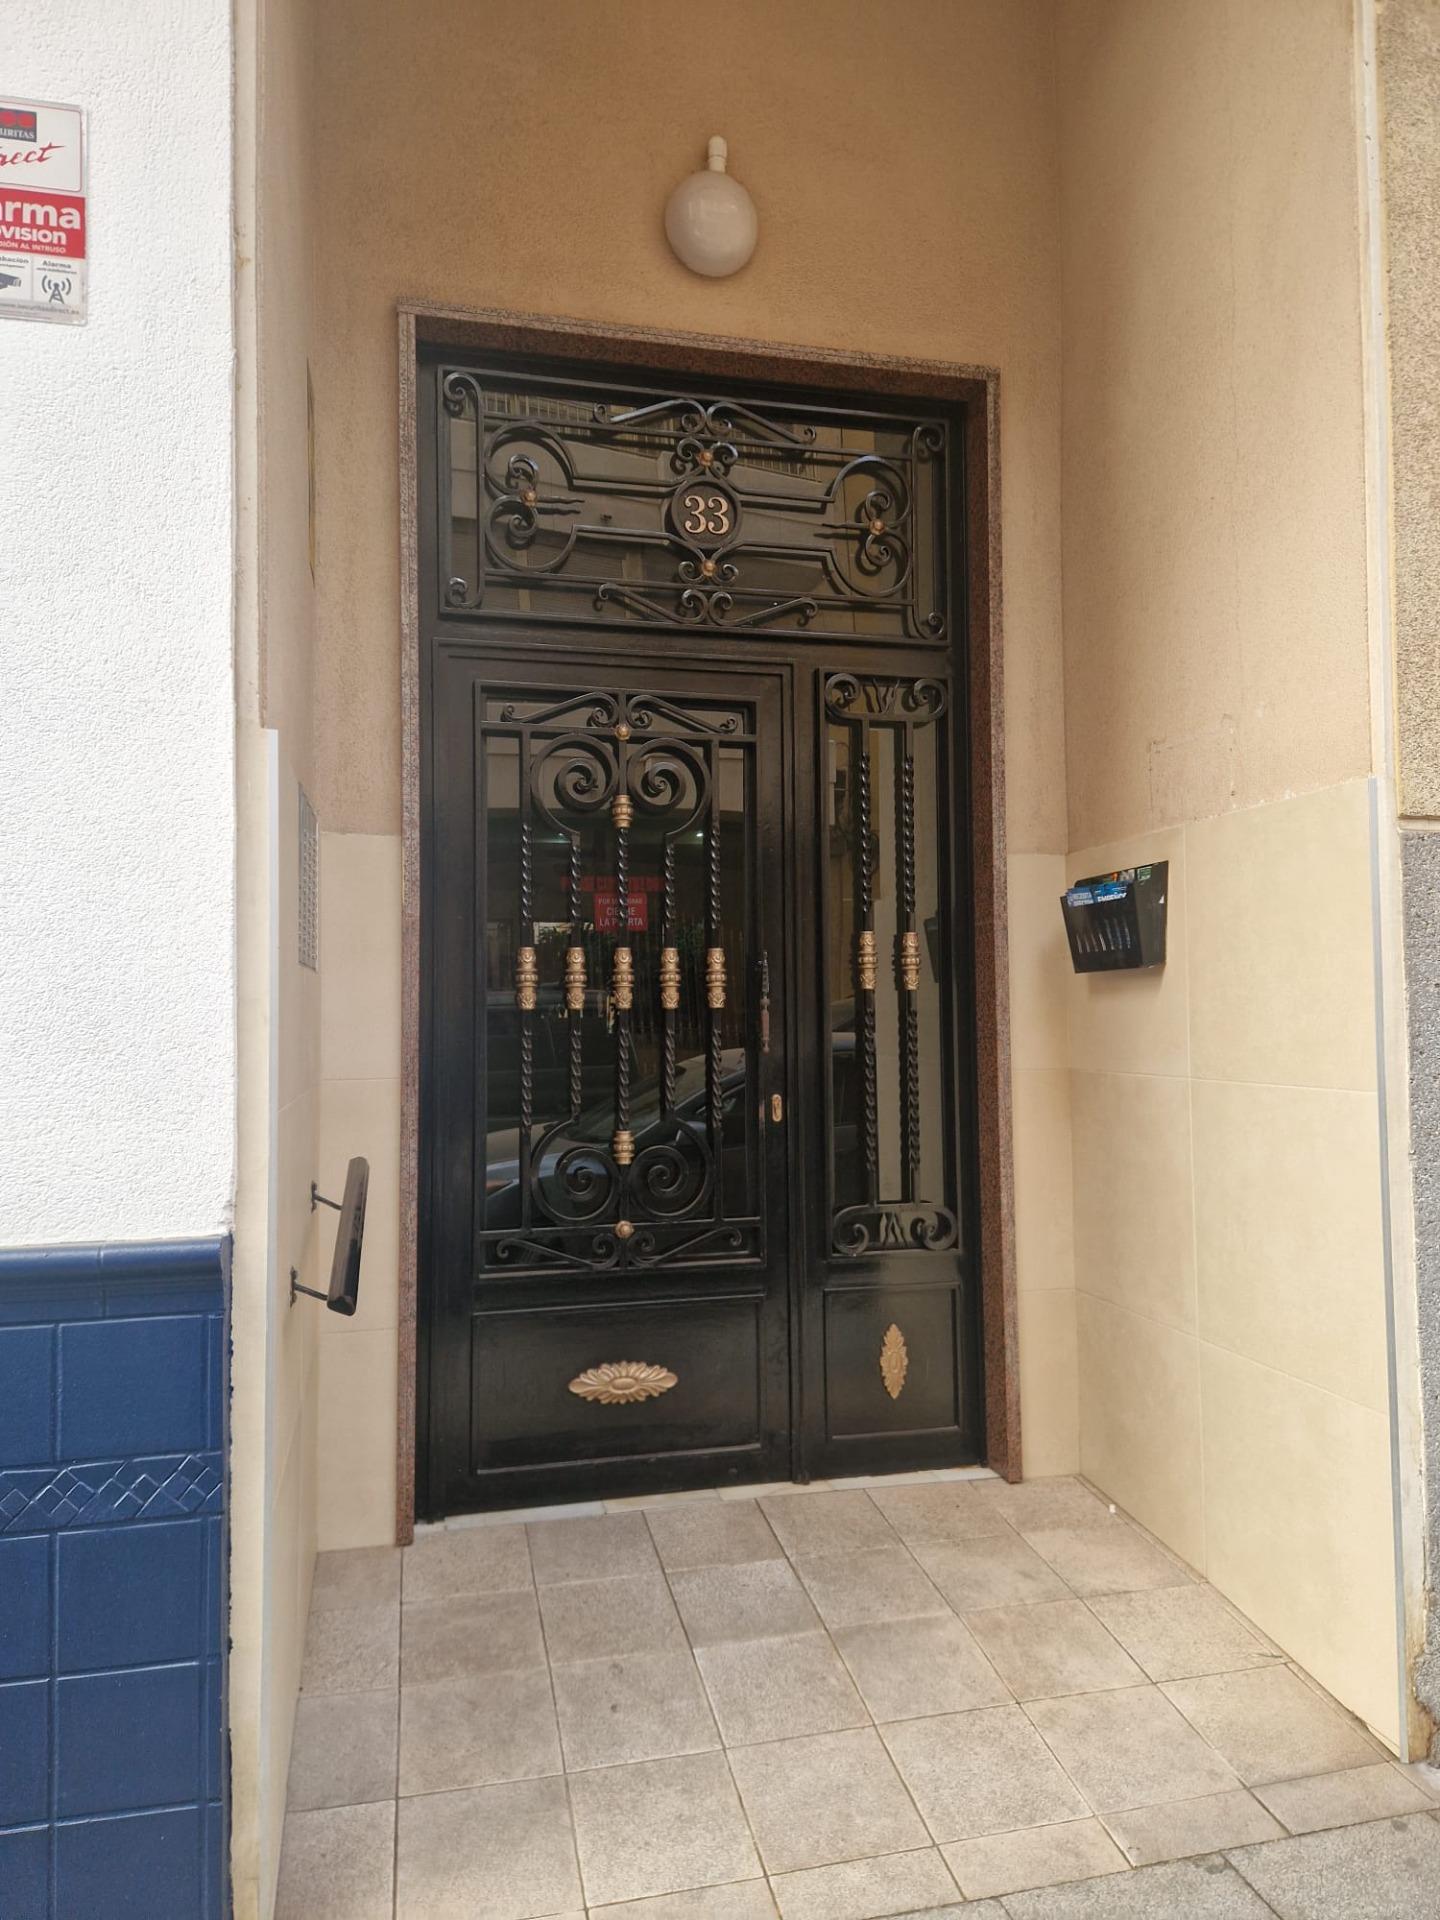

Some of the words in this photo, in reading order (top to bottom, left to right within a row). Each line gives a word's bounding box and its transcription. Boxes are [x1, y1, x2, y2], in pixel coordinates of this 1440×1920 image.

[20, 241, 30, 250] AL
[31, 243, 67, 254] INTRUSO
[42, 260, 71, 269] Alarma
[684, 495, 730, 534] 33
[606, 907, 636, 915] CIEE
[599, 917, 610, 926] LA
[611, 917, 643, 926] PRTA
